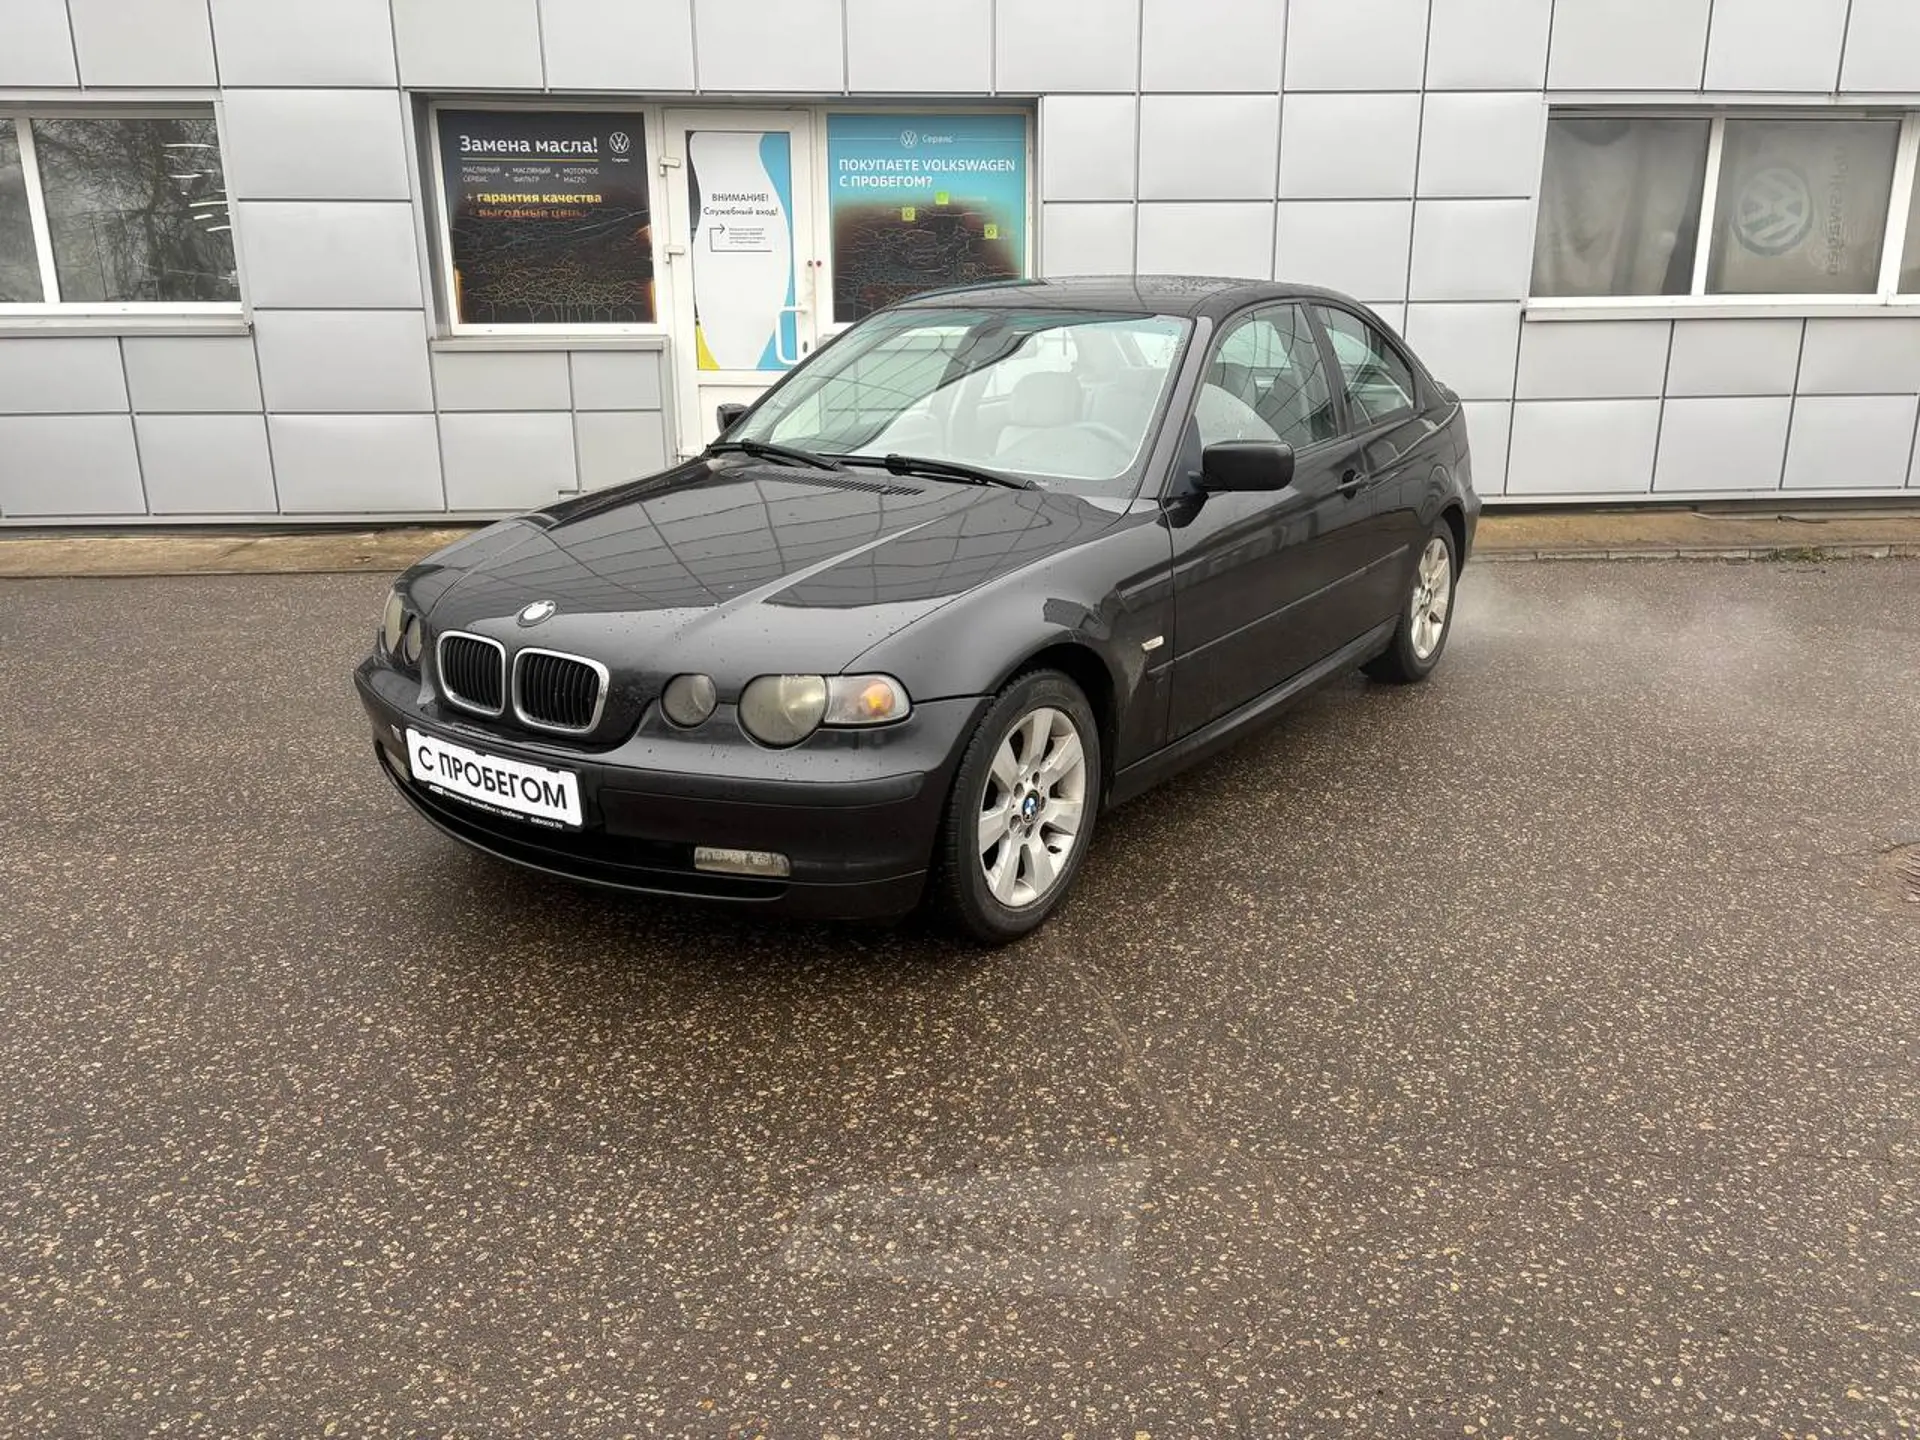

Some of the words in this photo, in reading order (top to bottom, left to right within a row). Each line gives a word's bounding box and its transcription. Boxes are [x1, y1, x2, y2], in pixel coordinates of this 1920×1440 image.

[459, 135, 531, 153] Замена
[535, 137, 599, 153] масла!
[922, 135, 953, 145] Сервис
[839, 159, 919, 171] ПОКУПАЕТЕ
[922, 159, 1015, 172] VOLKSWAGEN
[839, 176, 849, 187] С
[851, 176, 933, 188] ПРОБЕГОМ?
[476, 193, 540, 205] гарантия
[542, 194, 602, 203] качества
[711, 193, 769, 202] ВНИМАНИЕ!
[703, 206, 754, 217] Служебный
[756, 206, 778, 216] вход!
[418, 746, 434, 771] С
[439, 752, 568, 810] ПРОБЕГОМ
